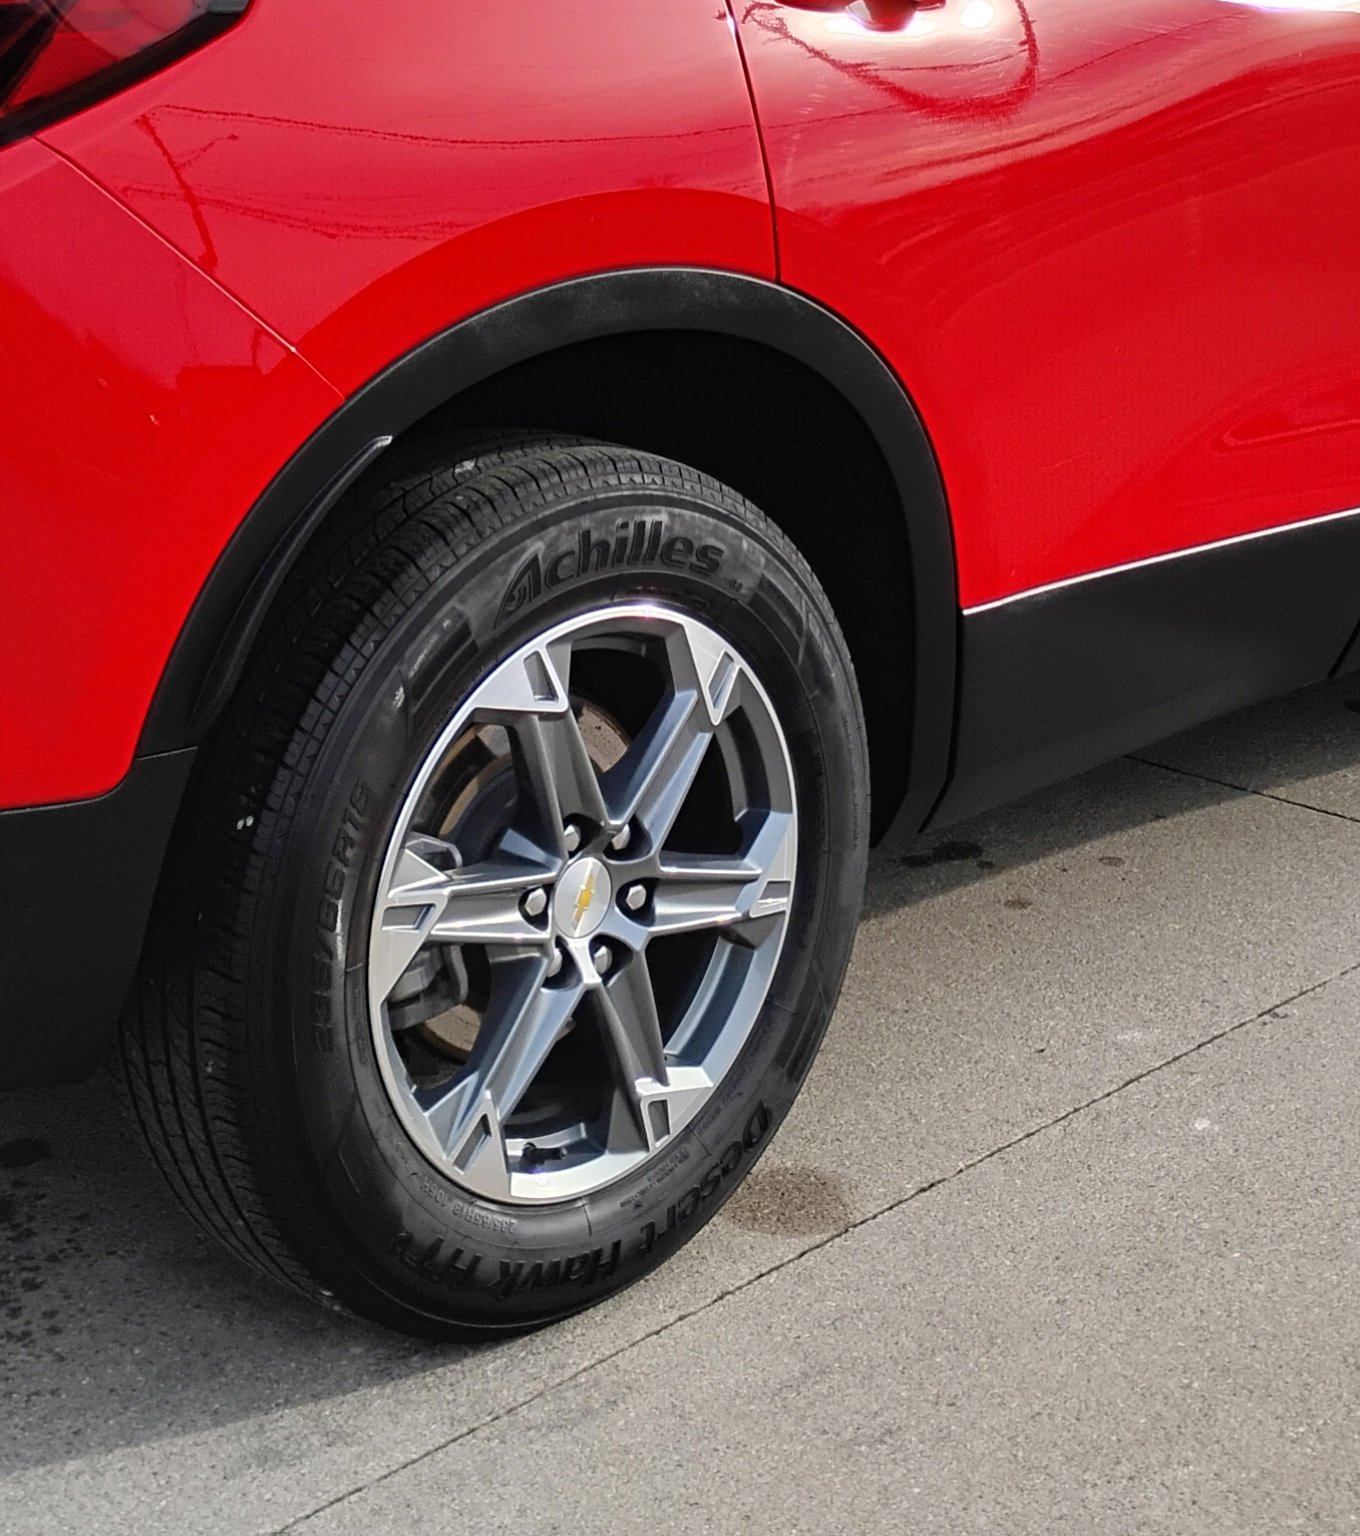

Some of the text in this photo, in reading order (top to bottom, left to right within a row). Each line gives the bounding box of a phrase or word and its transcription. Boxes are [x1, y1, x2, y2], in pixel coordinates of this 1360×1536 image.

[492, 517, 725, 630] Achilles
[641, 1102, 772, 1261] Desert
[488, 1239, 622, 1301] Hawk
